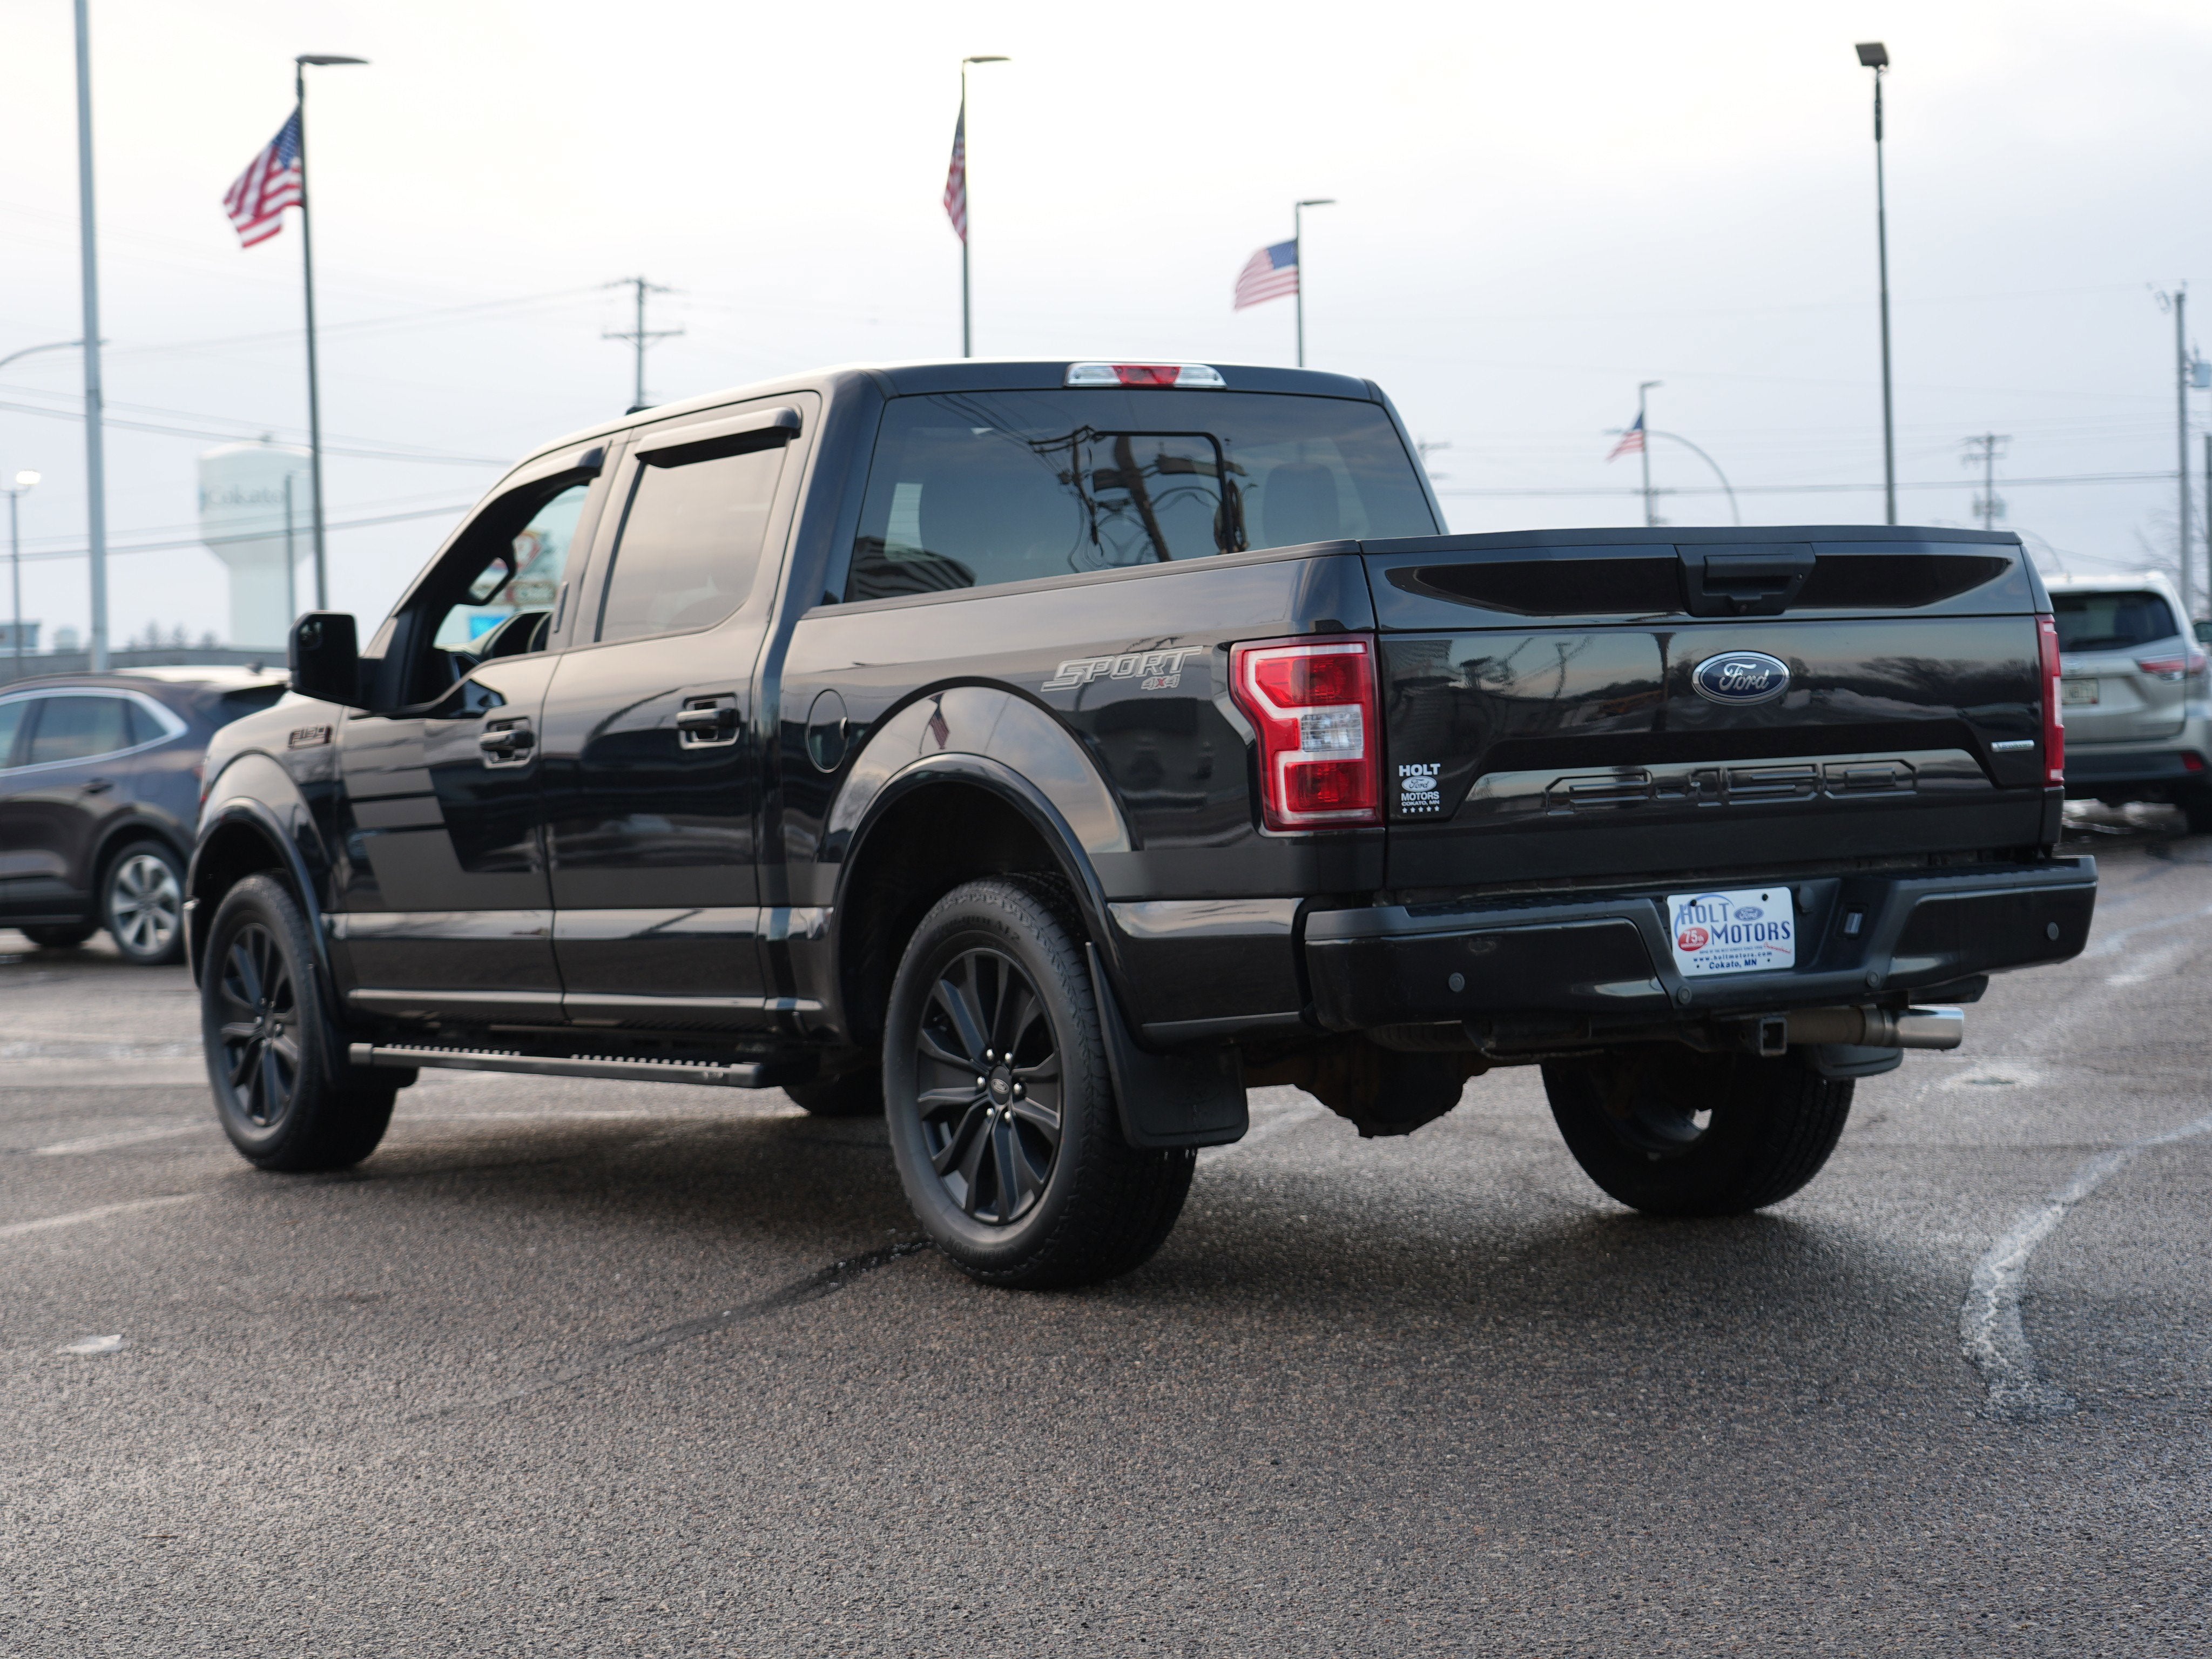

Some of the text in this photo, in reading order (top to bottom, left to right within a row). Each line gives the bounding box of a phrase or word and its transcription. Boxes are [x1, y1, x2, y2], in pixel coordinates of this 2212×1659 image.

[1040, 646, 1204, 692] SPORT
[1719, 663, 1770, 691] Ford
[1399, 763, 1441, 777] HOLT
[1409, 778, 1429, 788] Ford
[1545, 759, 1918, 816] F-150
[1401, 791, 1440, 801] MOTORS
[1678, 902, 1730, 924] HOLT
[1710, 920, 1791, 945] MOTORS
[1693, 951, 1772, 961] www.holtmotors.com
[1709, 961, 1742, 969] Cokato,
